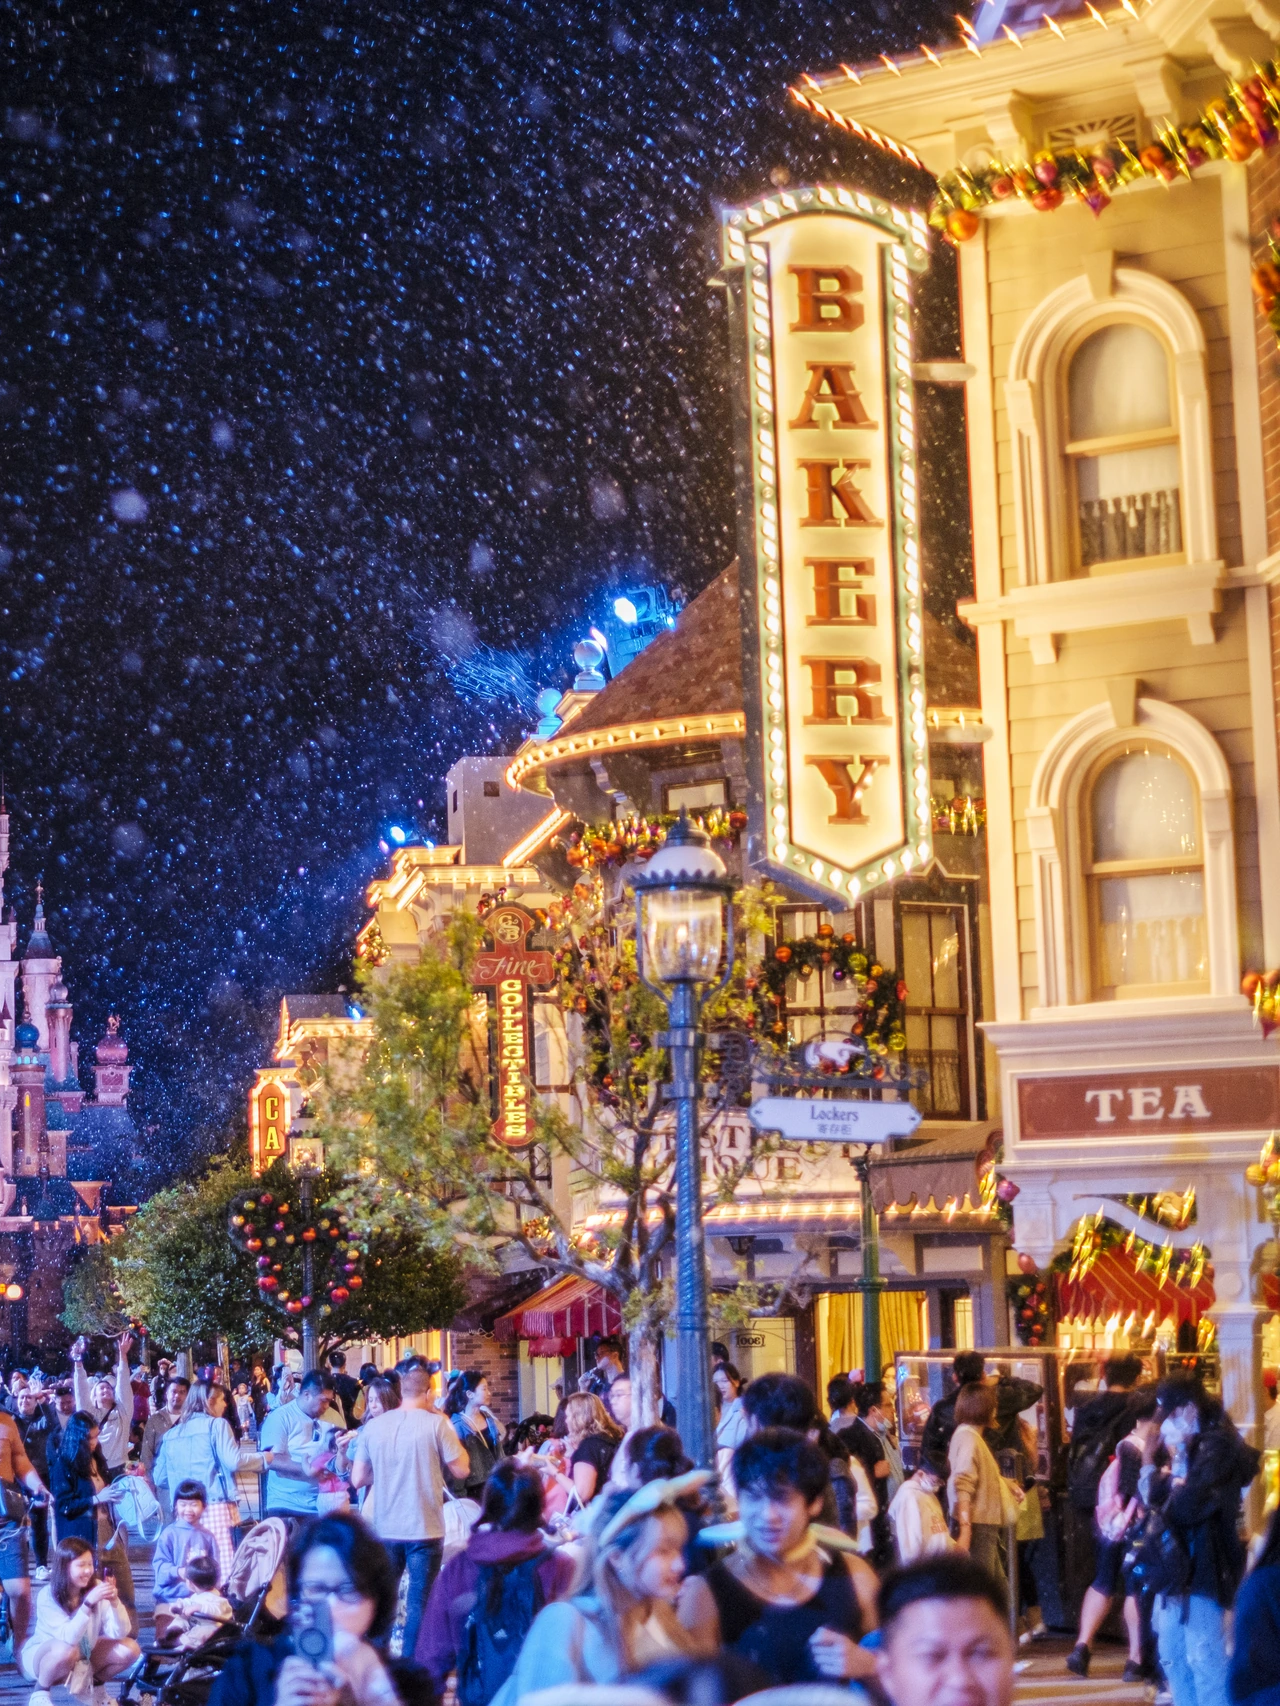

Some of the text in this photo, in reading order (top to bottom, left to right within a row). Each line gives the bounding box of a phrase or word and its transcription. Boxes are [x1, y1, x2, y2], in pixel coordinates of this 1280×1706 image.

[787, 263, 893, 826] BAKERY
[477, 955, 547, 980] Fine
[500, 979, 527, 1138] COLLECTIBLES
[810, 1104, 860, 1122] Lockers
[1085, 1085, 1212, 1122] TEA
